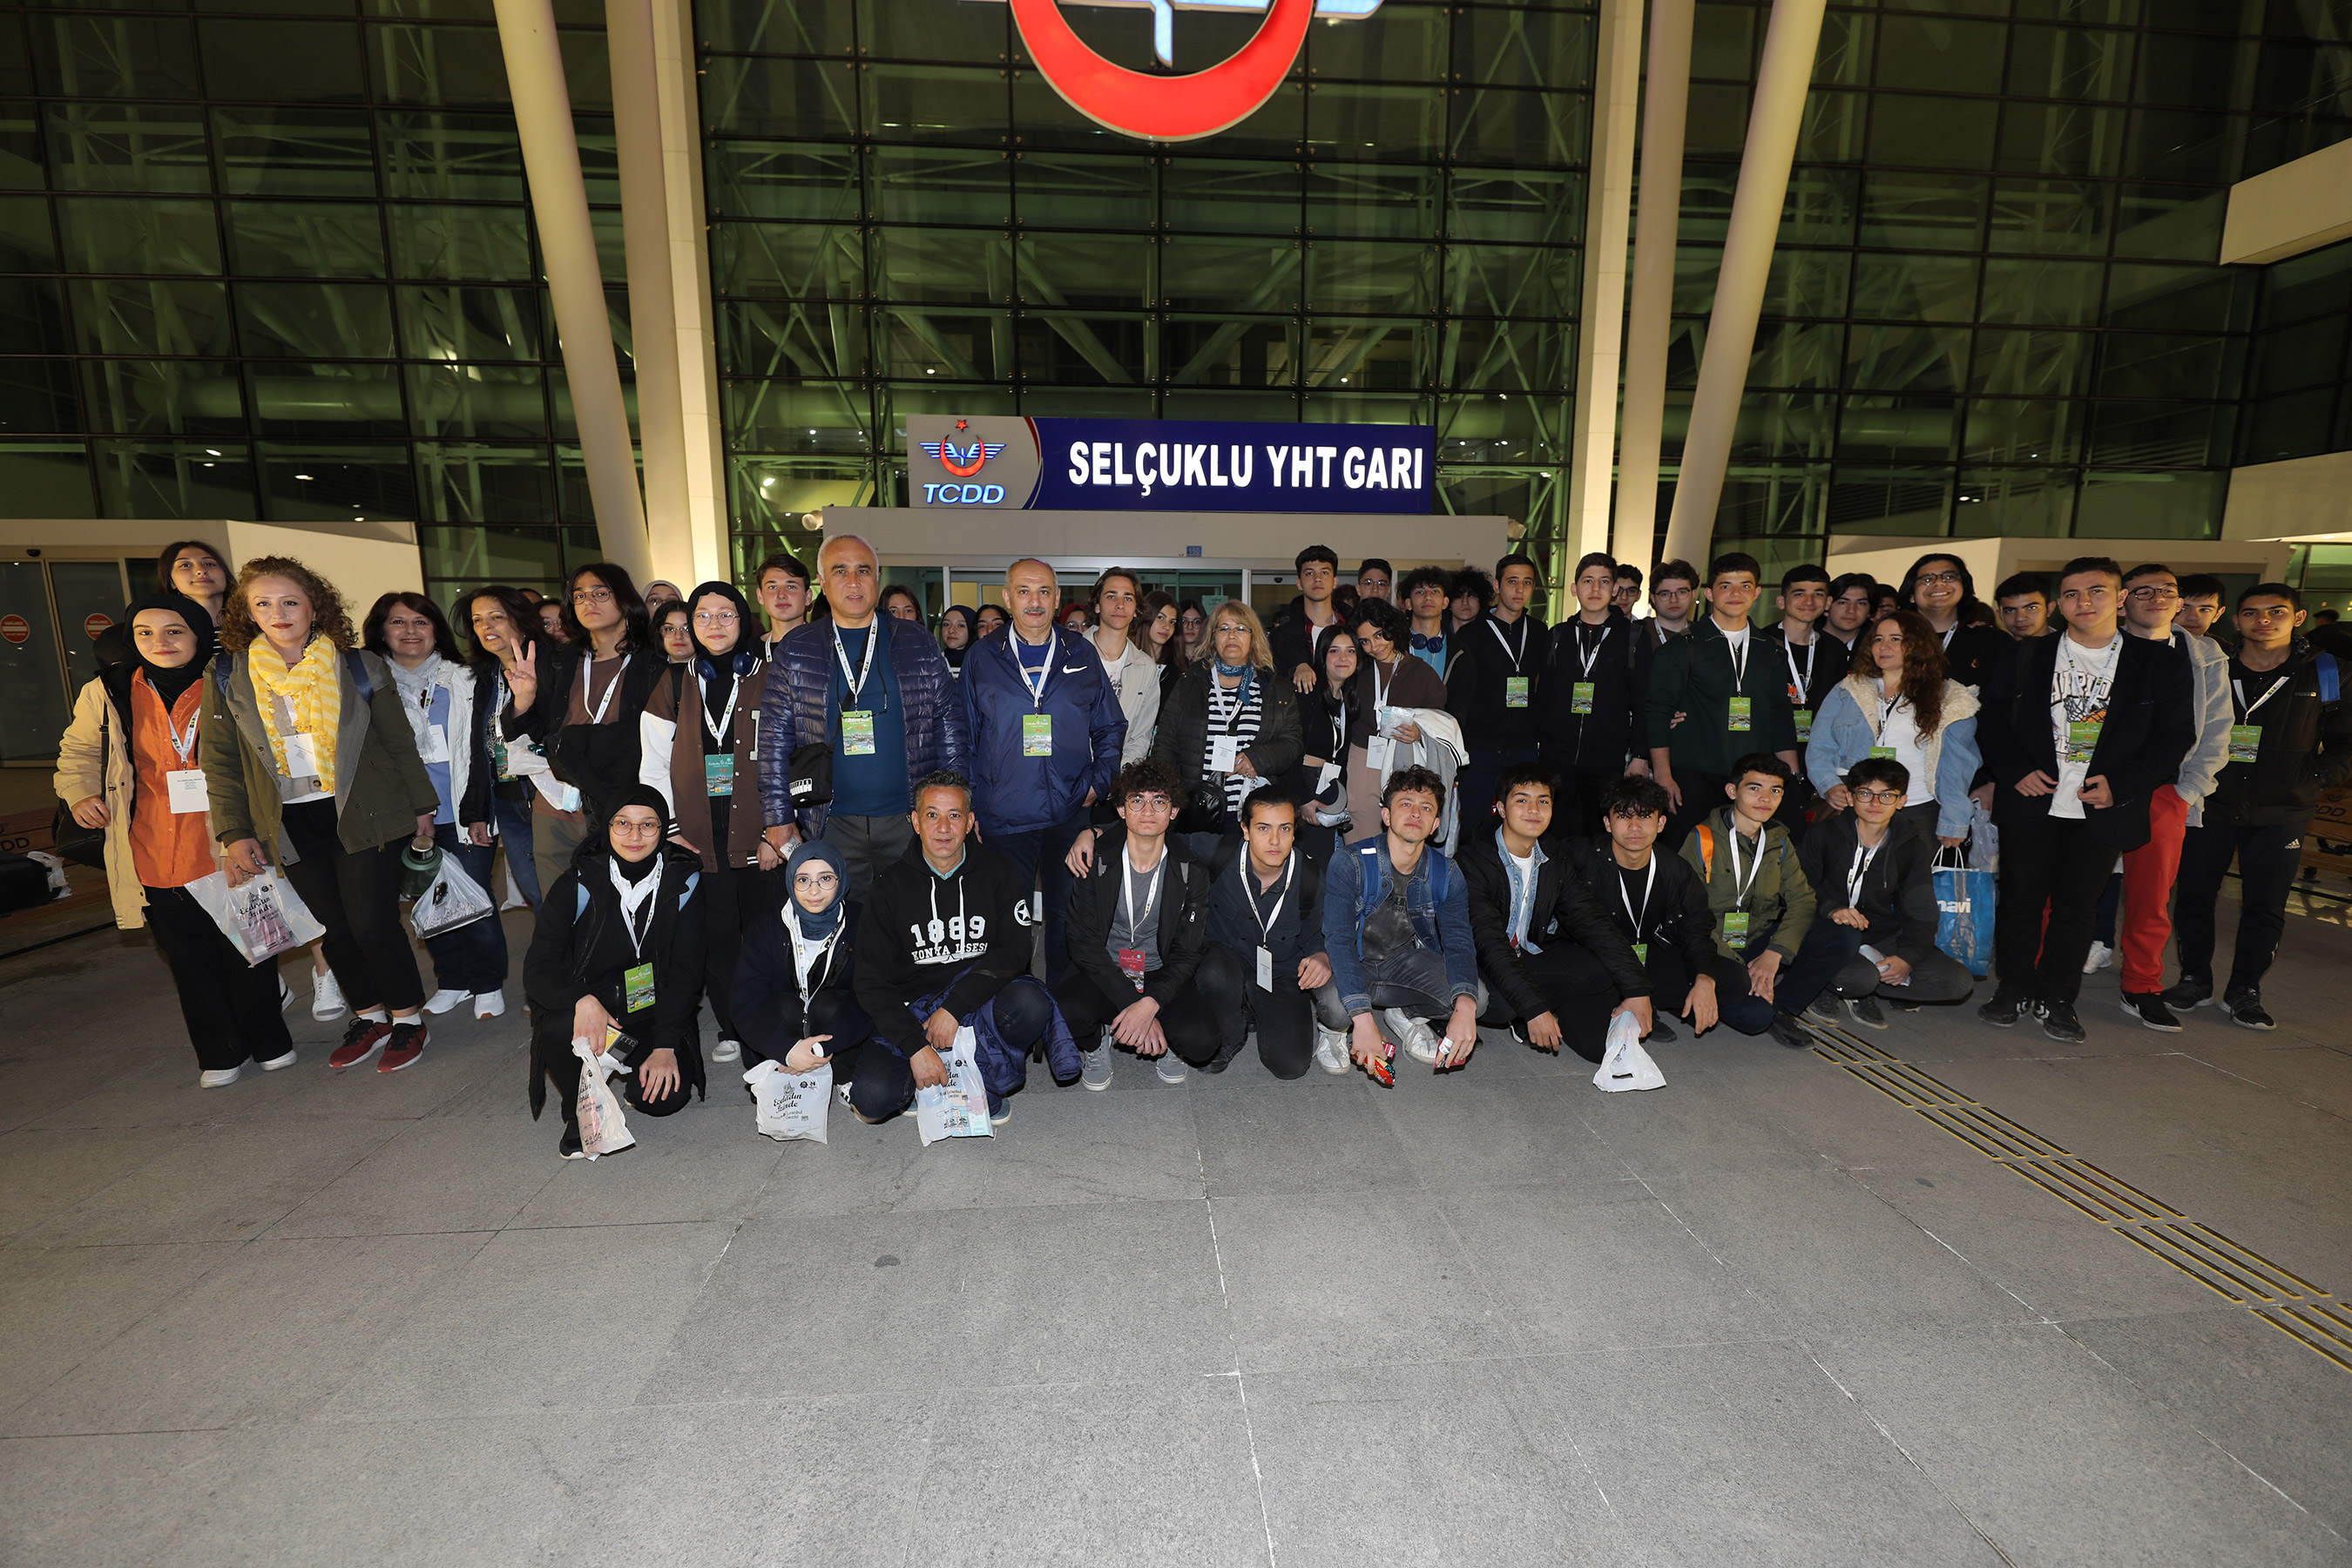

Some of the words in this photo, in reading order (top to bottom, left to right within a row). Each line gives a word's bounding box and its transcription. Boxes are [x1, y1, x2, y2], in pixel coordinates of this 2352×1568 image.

[1068, 441, 1254, 497] SELÇUKLU
[1267, 445, 1337, 488] YHT
[1343, 446, 1423, 490] GARI
[923, 483, 1005, 504] TCDD
[910, 916, 986, 948] 1889
[911, 946, 950, 961] KONYA
